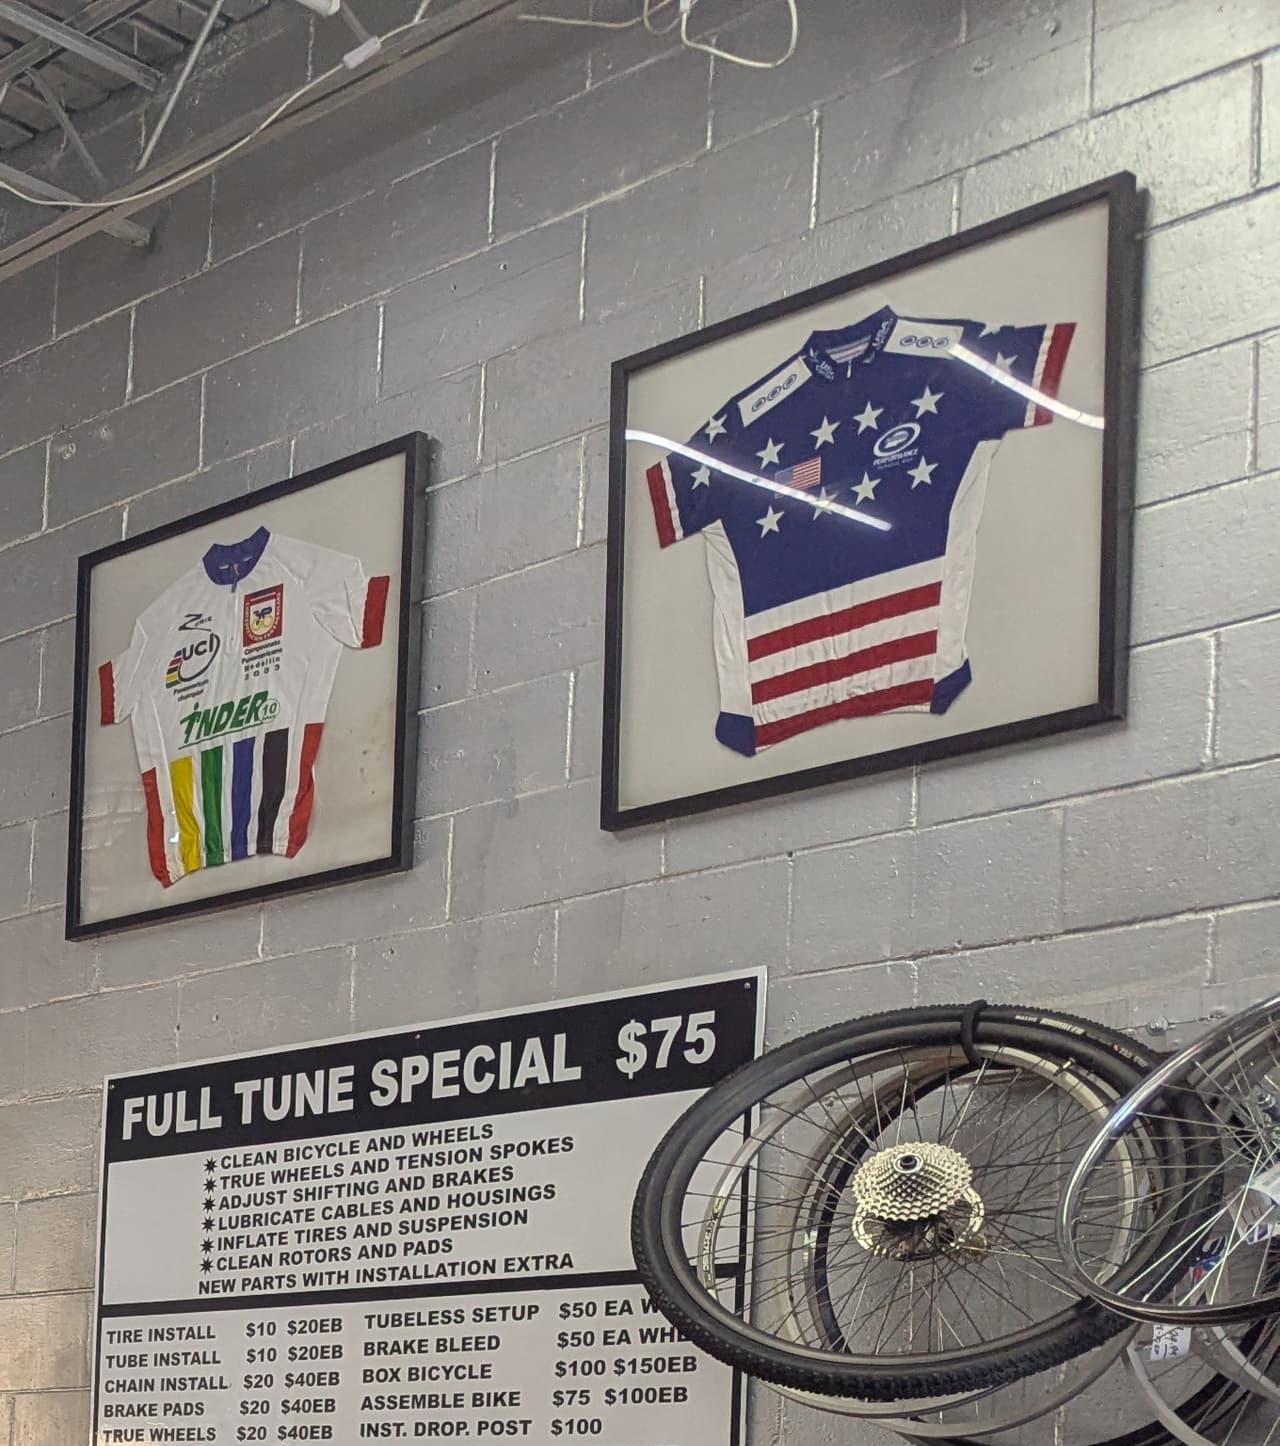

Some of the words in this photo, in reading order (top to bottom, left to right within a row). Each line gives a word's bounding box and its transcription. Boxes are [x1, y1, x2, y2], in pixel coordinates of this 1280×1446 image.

[182, 632, 214, 660] UCI
[123, 1087, 222, 1140] FULL
[235, 1065, 354, 1124] TUNE
[370, 1034, 582, 1107] SPECIAL
[616, 1010, 715, 1079] $75
[221, 1150, 277, 1169] CLEAN
[284, 1140, 360, 1163] BICYCLE
[366, 1135, 405, 1153] AND
[412, 1124, 494, 1147] WHEELS
[220, 1172, 265, 1189] TRUE
[271, 1163, 344, 1184] WHEELS
[350, 1158, 389, 1175] AND
[396, 1147, 482, 1170] TENSION
[490, 1137, 573, 1160] SPOKES
[219, 1190, 287, 1210] ADJUST
[293, 1181, 381, 1204] SHIFTING
[385, 1176, 425, 1193] AND
[433, 1166, 513, 1188] BRAKES
[218, 1209, 315, 1231] LUBRICATE
[322, 1200, 393, 1220] CABLES
[400, 1196, 440, 1213] AND
[448, 1184, 555, 1209] HOUSINGS
[218, 1231, 288, 1251] INFLATE
[295, 1226, 346, 1244] TIRES
[353, 1222, 392, 1239] AND
[398, 1209, 527, 1235] SUSPENSION
[217, 1253, 272, 1271] CLEAN
[280, 1247, 351, 1266] ROTORS
[358, 1243, 396, 1259] AND
[404, 1239, 452, 1256] PADS
[199, 1279, 236, 1294] NEW
[242, 1274, 296, 1291] PARTS
[303, 1270, 349, 1287] WITH
[356, 1259, 497, 1284] INSTALLATION
[504, 1253, 573, 1273] EXTRA
[365, 1309, 464, 1329] TUBELESS
[472, 1305, 539, 1322] SETUP
[559, 1302, 597, 1320] $50
[605, 1300, 633, 1316] EA
[107, 1330, 142, 1344] TIRE
[149, 1326, 215, 1342] INSTALL
[246, 1322, 276, 1337] $10
[287, 1318, 342, 1335] $20EB
[364, 1339, 428, 1356] BRAKE
[436, 1336, 500, 1352] BLEED
[557, 1331, 594, 1349] $50
[603, 1329, 631, 1345] EA
[106, 1354, 148, 1368] TUBE
[154, 1351, 221, 1366] INSTALL
[247, 1348, 276, 1363] $10
[288, 1345, 343, 1361] $20EB
[363, 1368, 401, 1383] BOX
[408, 1364, 492, 1381] BICYCLE
[555, 1360, 605, 1378] $100
[614, 1356, 697, 1376] $150EB
[105, 1379, 154, 1393] CHAIN
[161, 1376, 228, 1391] INSTALL
[244, 1374, 273, 1389] $20
[285, 1372, 339, 1388] $40EB
[104, 1404, 157, 1417] BRAKE
[164, 1402, 204, 1416] PADS
[240, 1400, 269, 1415] $20
[281, 1399, 335, 1414] $40EB
[361, 1393, 464, 1410] ASSEMBLE
[472, 1392, 520, 1407] BIKE
[553, 1390, 590, 1407] $75
[605, 1387, 687, 1405] $100EB
[103, 1429, 144, 1442] TRUE
[150, 1428, 216, 1441] WHEELS
[237, 1426, 266, 1441] $20
[278, 1426, 332, 1440] $40EB
[360, 1423, 406, 1437] INST.
[415, 1422, 469, 1436] DROP.
[478, 1420, 532, 1435] POST
[551, 1419, 601, 1436] $100
